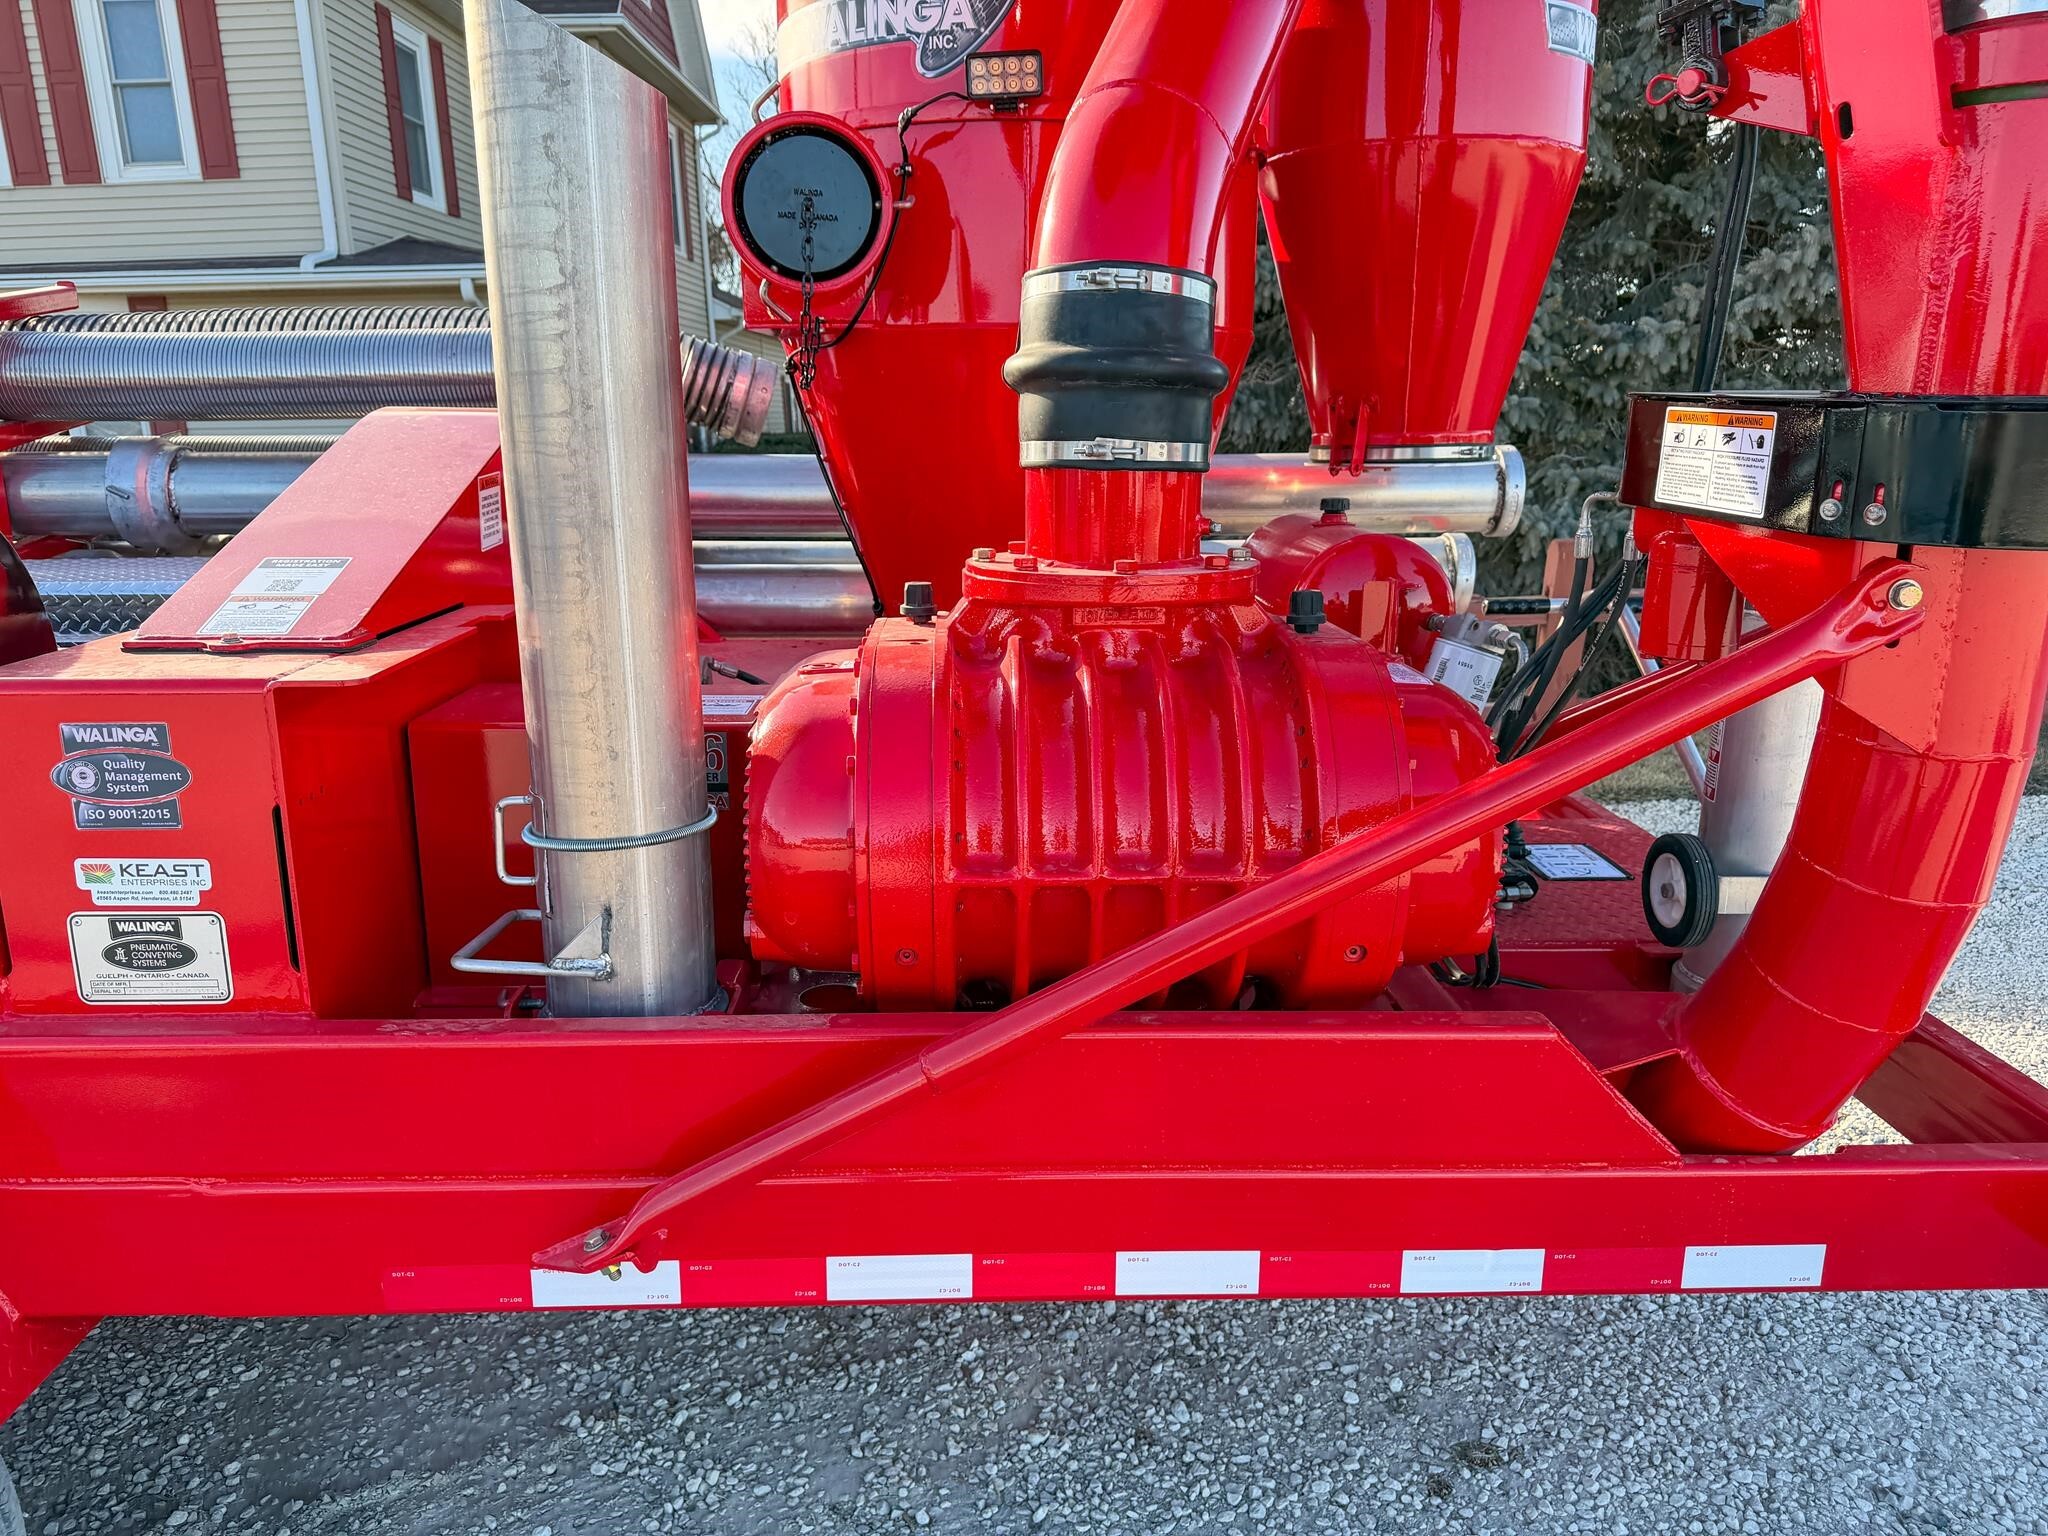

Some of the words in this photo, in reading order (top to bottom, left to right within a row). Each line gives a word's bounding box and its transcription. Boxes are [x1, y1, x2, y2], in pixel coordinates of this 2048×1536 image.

[824, 0, 979, 46] ALINGA
[928, 33, 958, 49] INC.
[1683, 412, 1709, 423] WARNING
[1734, 416, 1764, 426] WARNING
[103, 759, 146, 771] Quality
[104, 771, 182, 783] Management
[107, 783, 149, 794] System
[84, 809, 105, 820] ISO
[108, 809, 171, 820] 9001:2015
[119, 863, 205, 878] KEAST
[190, 879, 207, 887] INC
[130, 943, 177, 951] PNEUMATIC
[131, 951, 182, 959] CONVEYING
[132, 959, 167, 967] SYSTEMS
